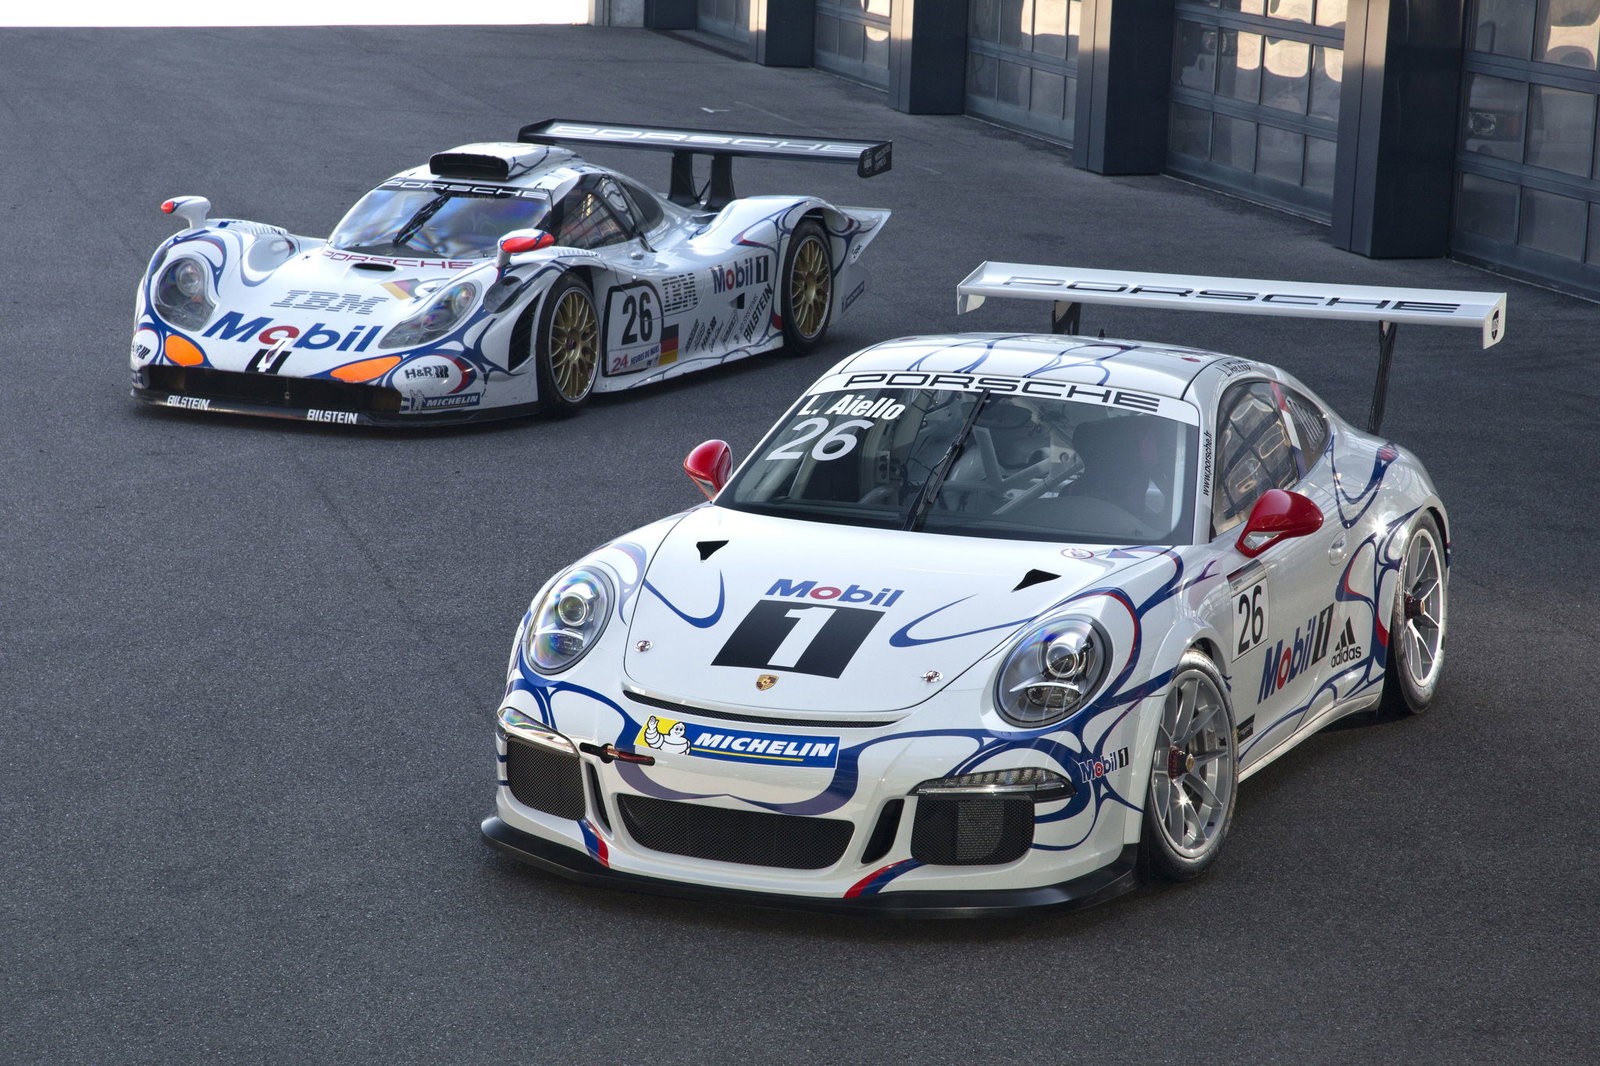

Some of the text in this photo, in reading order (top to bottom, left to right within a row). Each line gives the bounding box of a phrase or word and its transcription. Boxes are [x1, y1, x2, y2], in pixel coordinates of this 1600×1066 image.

[545, 125, 864, 152] PORSCHE
[382, 180, 548, 200] PORSCHE
[322, 250, 473, 270] PORSCHE
[711, 256, 753, 294] Mobil
[270, 289, 389, 315] IBM
[661, 273, 698, 312] IBM
[1004, 276, 1460, 313] PORSCHE
[621, 291, 652, 345] 26
[743, 283, 773, 343] BILSTEIN
[201, 311, 384, 352] Mobil
[405, 366, 434, 379] H&R
[611, 355, 629, 372] 24
[167, 395, 210, 410] BILSTEIN
[426, 395, 477, 407] MICHELIN
[843, 373, 1160, 412] PORSCHE
[307, 409, 358, 424] BILSTEIN
[797, 394, 906, 420] L. Aiello
[765, 417, 875, 461] 26
[1203, 430, 1212, 497] www.porsche.fr
[765, 579, 904, 607] Mobil
[1238, 585, 1264, 655] 26
[1257, 615, 1317, 704] Mobil
[1331, 646, 1362, 668] adidas
[693, 733, 836, 757] MICHELIN
[1079, 752, 1117, 783] Mobil
